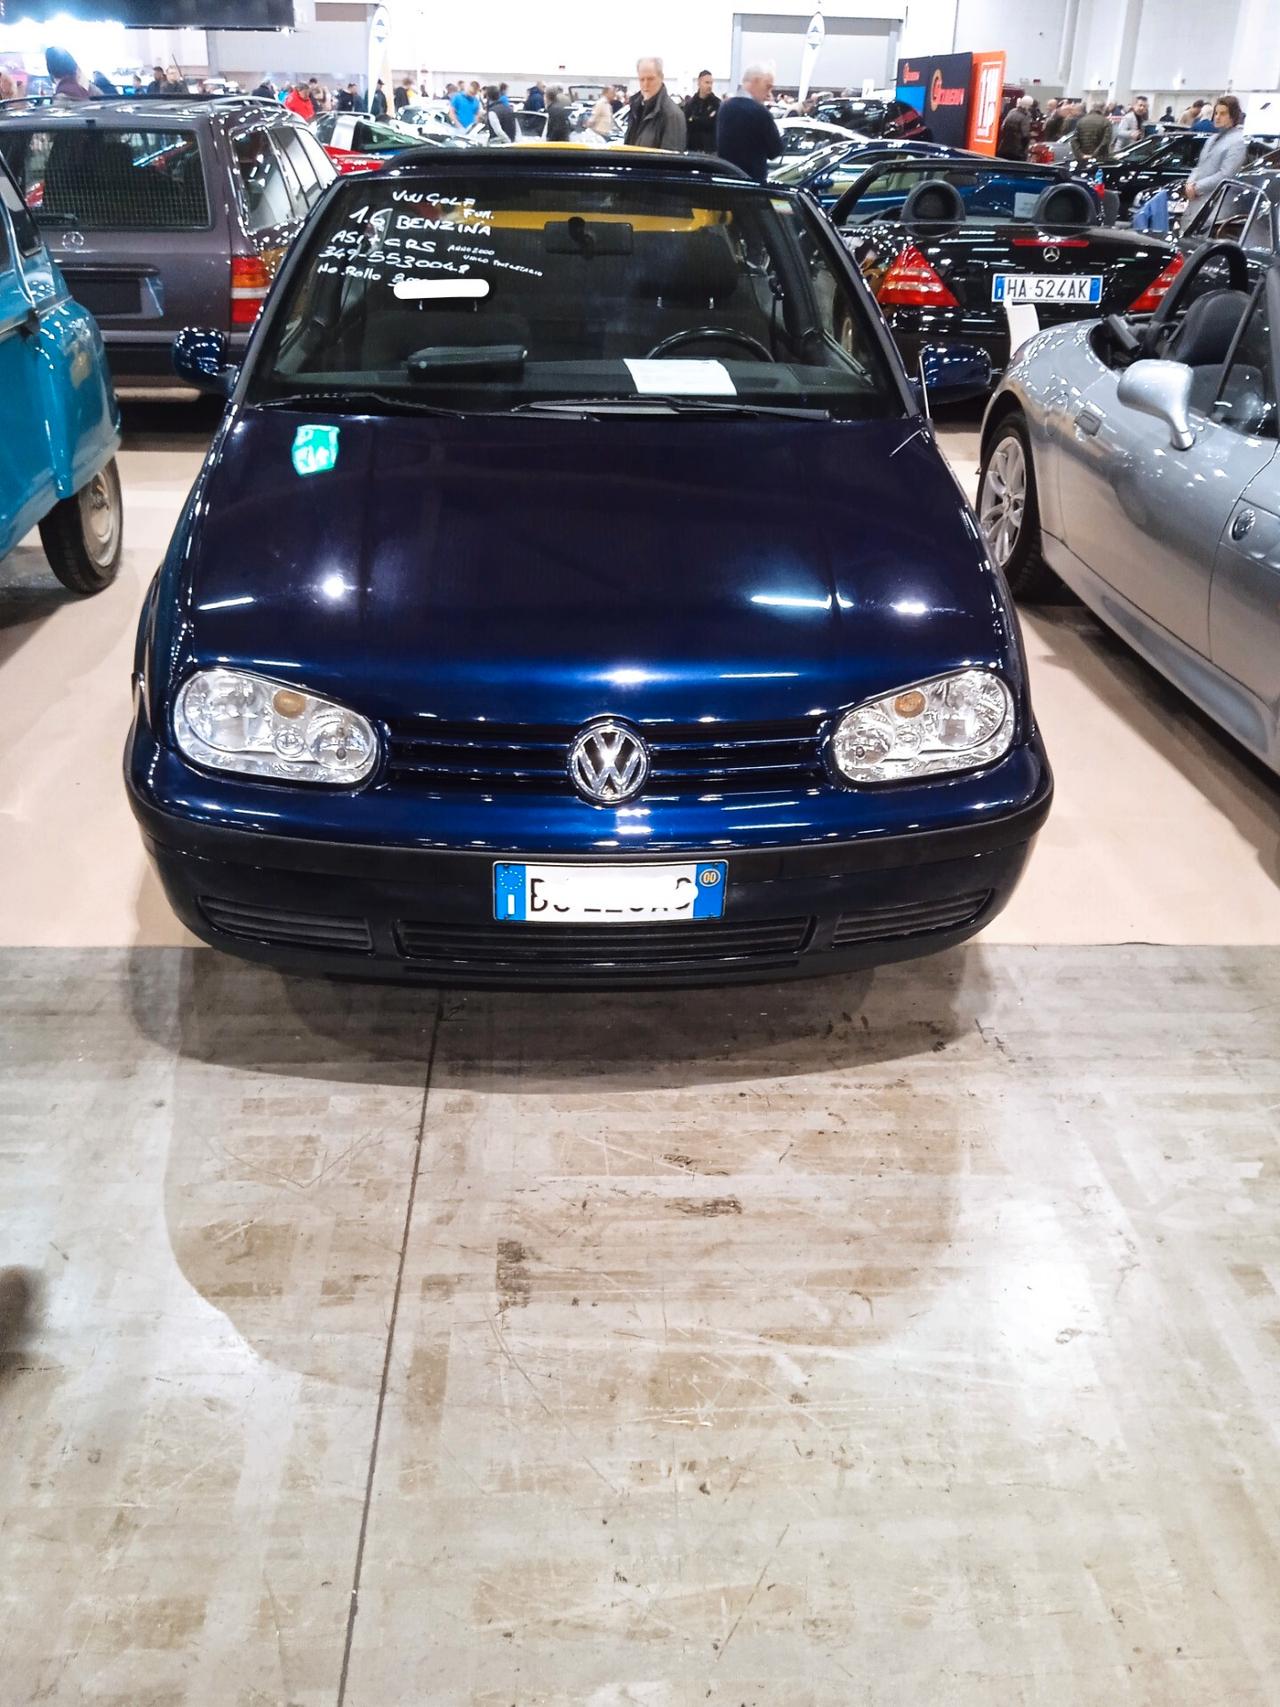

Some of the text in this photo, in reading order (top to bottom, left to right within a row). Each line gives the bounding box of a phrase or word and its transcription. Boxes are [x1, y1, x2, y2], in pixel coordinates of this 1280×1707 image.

[349, 206, 491, 236] 1.6 BENZINA
[331, 230, 364, 244] ASI
